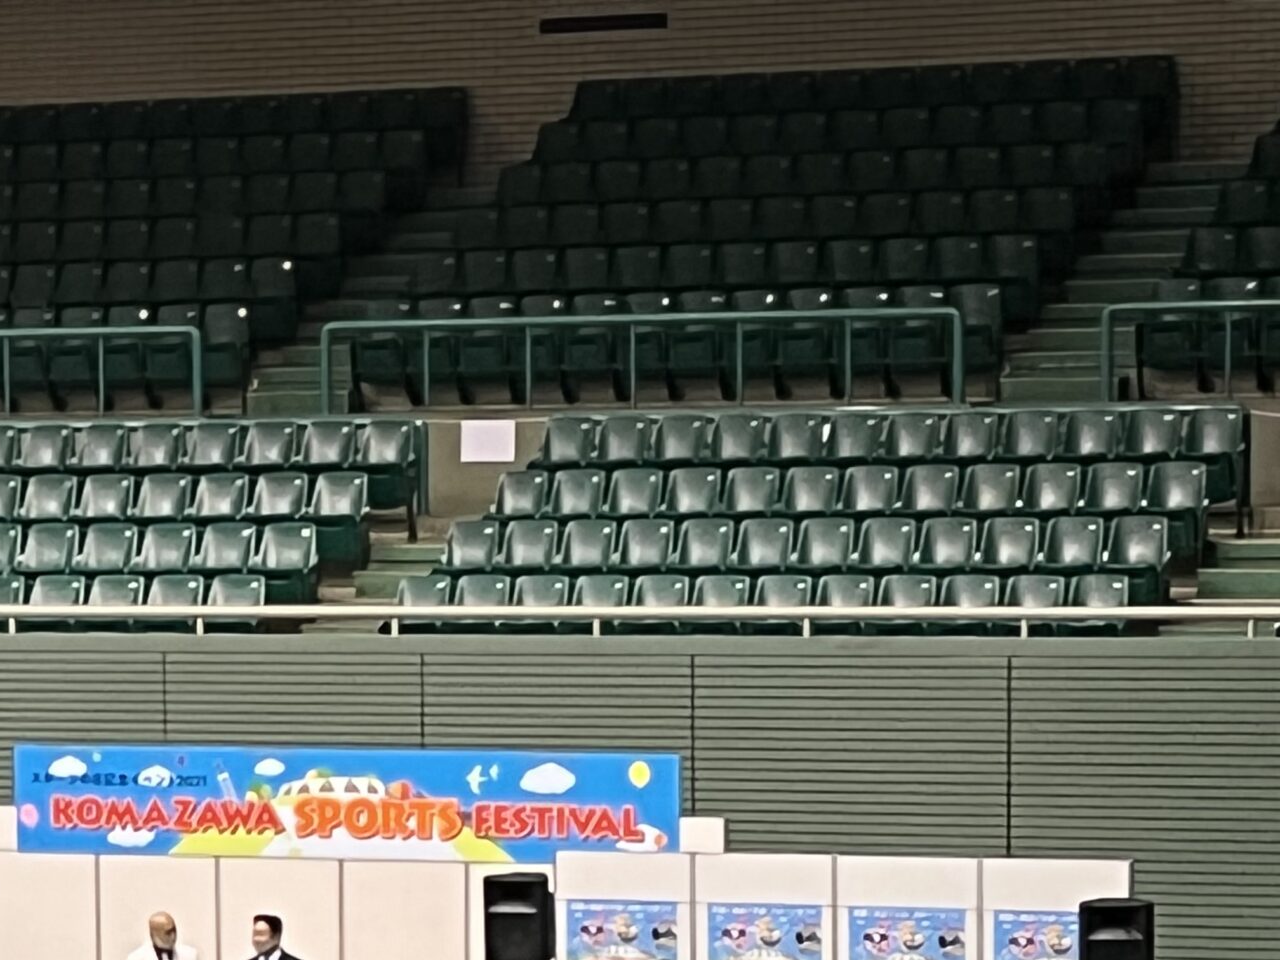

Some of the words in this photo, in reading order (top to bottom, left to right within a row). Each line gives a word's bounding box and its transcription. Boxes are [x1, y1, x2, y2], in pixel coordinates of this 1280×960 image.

[51, 793, 286, 835] KOMAZAWA
[294, 797, 464, 842] SPORTS
[473, 803, 645, 842] FESTIVAL
